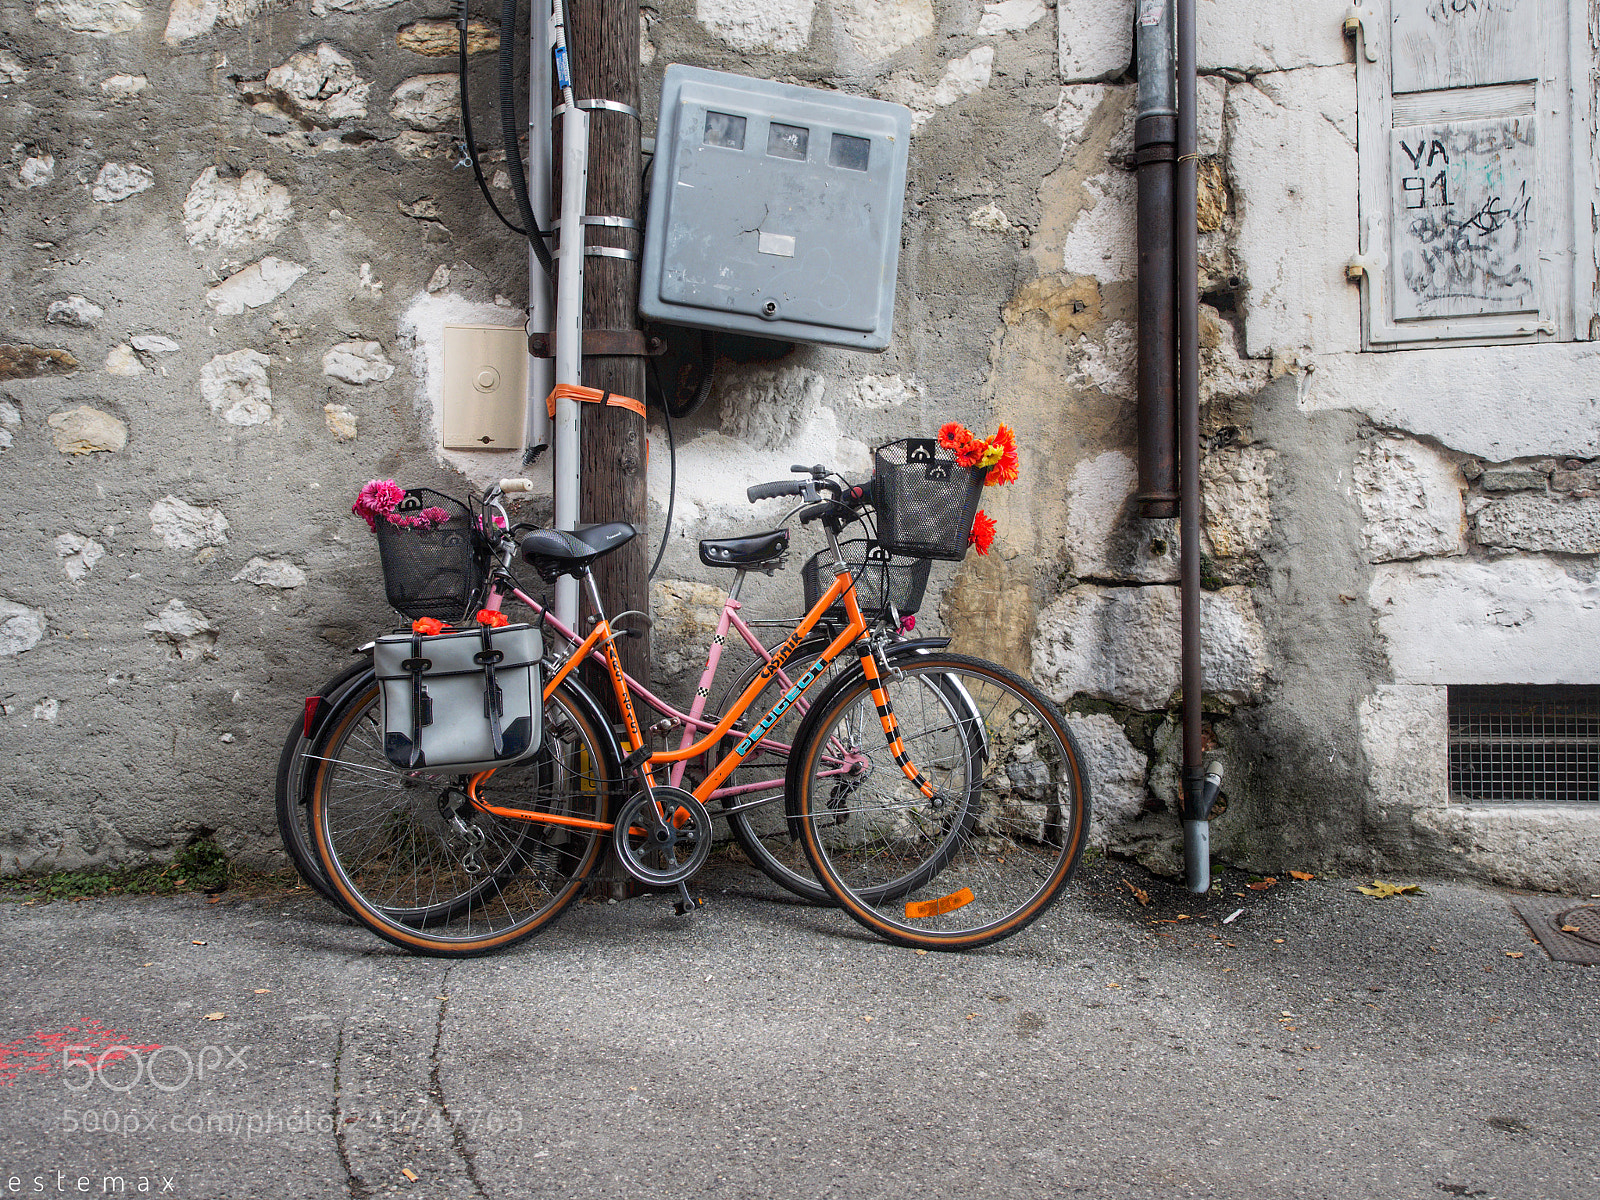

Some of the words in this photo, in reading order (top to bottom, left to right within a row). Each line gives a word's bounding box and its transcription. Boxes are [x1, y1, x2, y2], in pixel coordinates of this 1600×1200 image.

[605, 640, 623, 682] MARS
[622, 692, 638, 734] 2015
[735, 657, 826, 757] PEUGEOT
